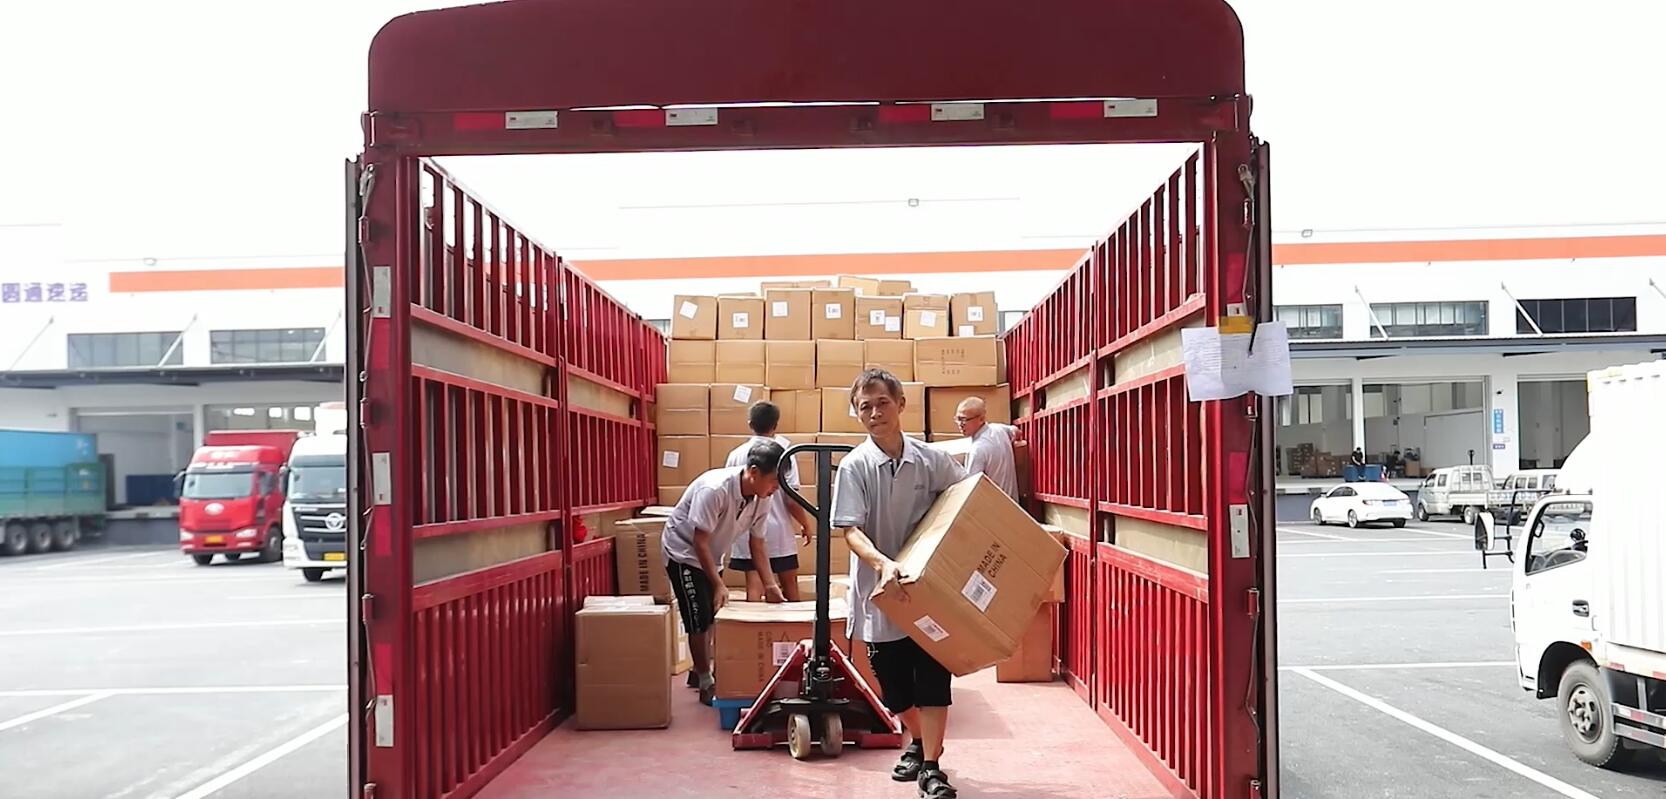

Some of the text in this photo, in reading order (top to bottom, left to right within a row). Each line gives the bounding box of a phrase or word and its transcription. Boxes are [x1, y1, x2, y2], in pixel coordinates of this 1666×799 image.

[636, 533, 649, 592] MADE IN CHINA
[977, 550, 995, 574] MADE
[991, 540, 1001, 552] IN
[987, 553, 1007, 578] CHINA
